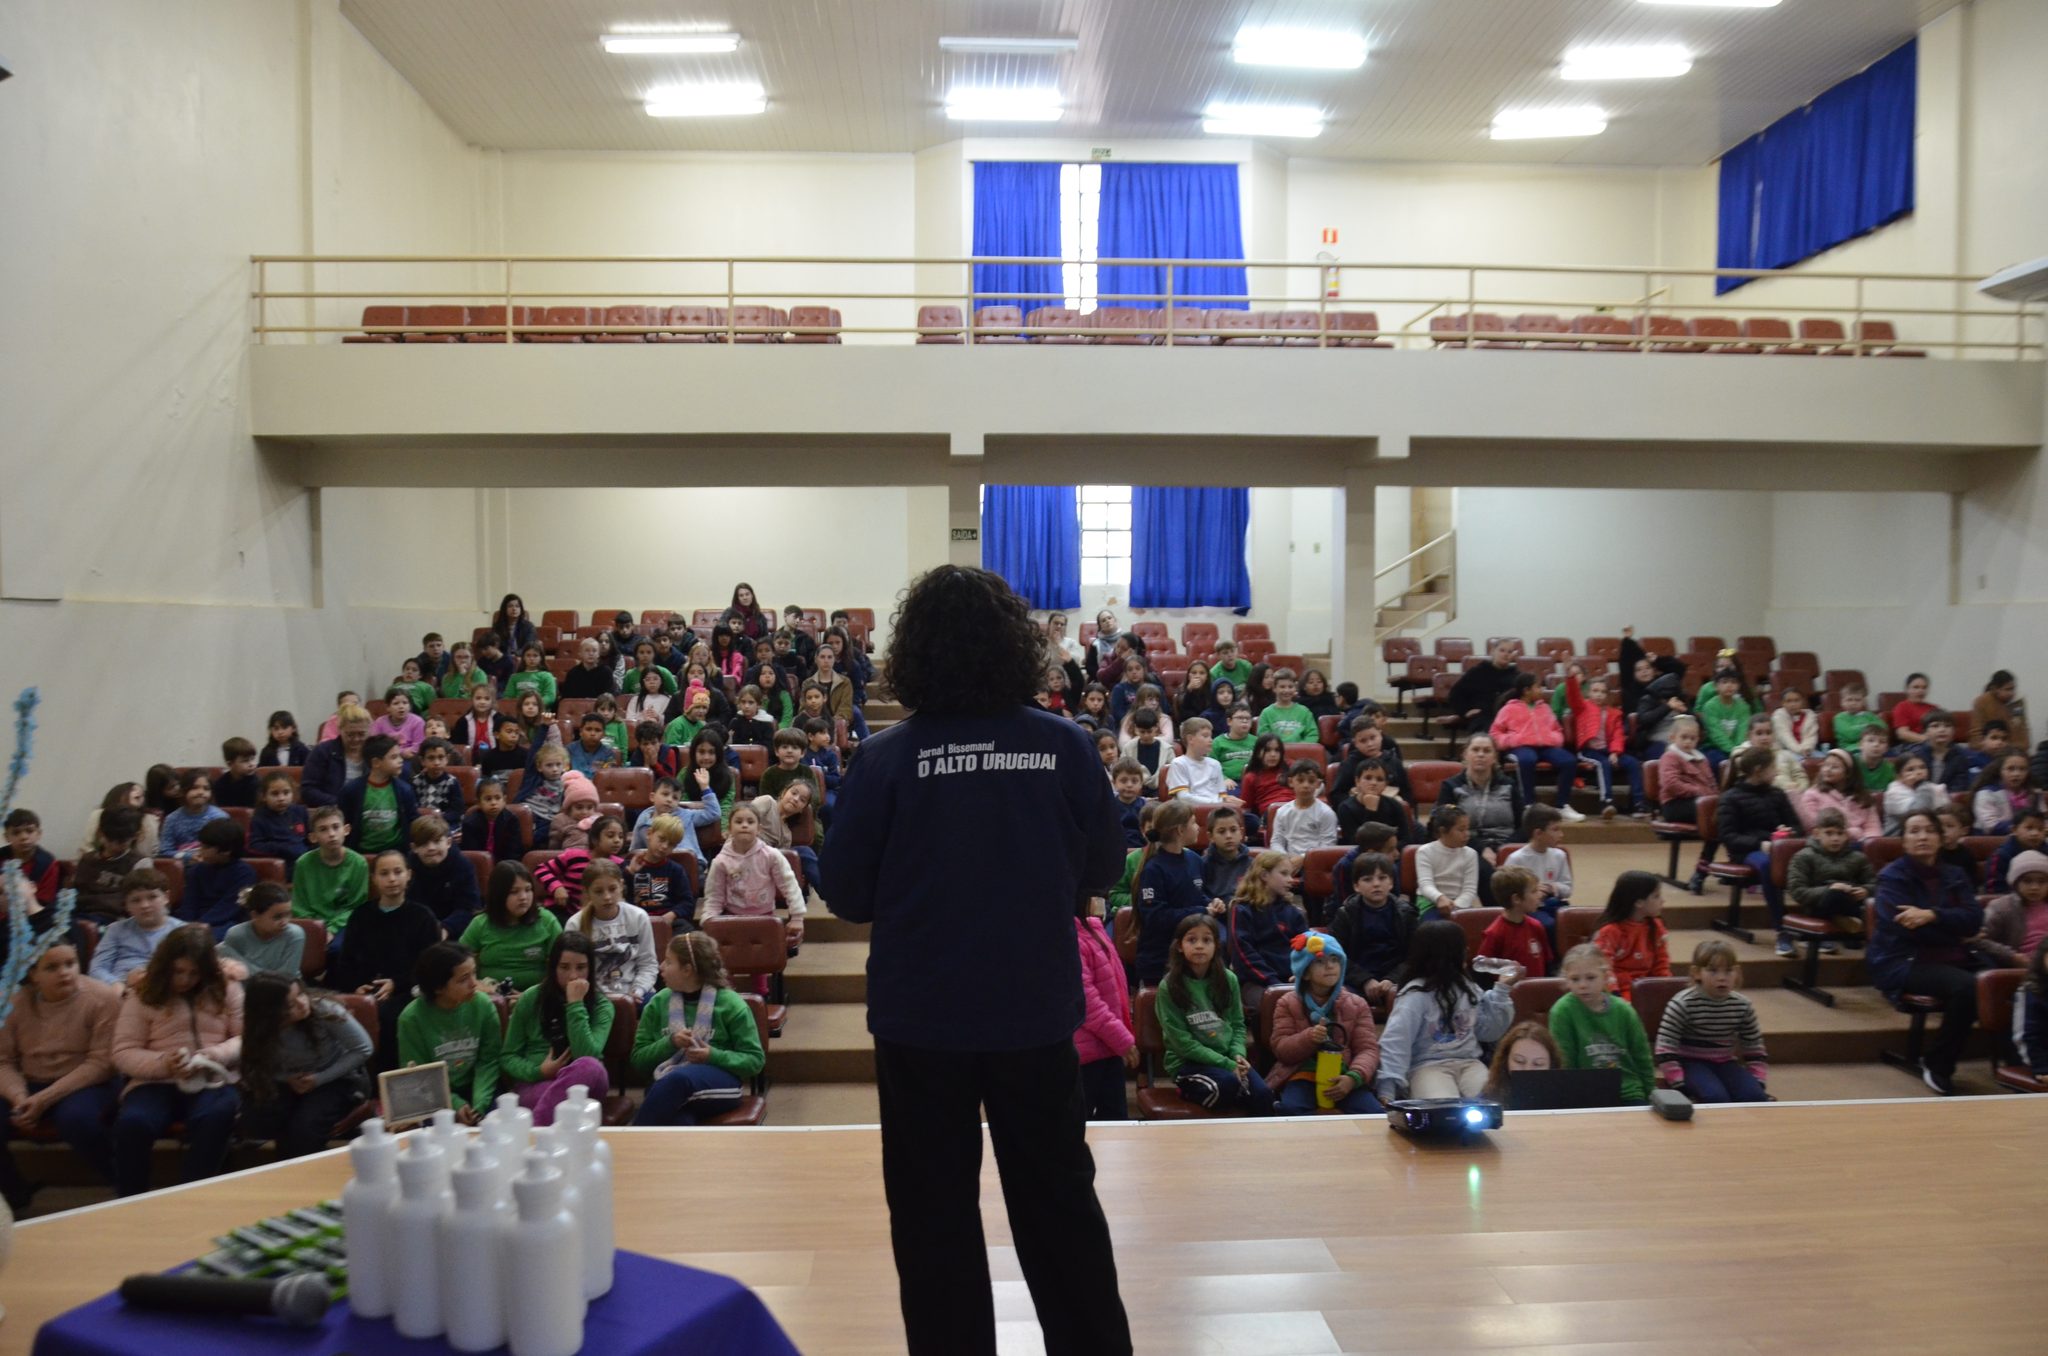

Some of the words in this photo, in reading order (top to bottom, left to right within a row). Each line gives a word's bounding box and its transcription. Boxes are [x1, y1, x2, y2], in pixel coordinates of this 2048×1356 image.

[917, 744, 944, 759] Jornal
[948, 740, 995, 754] Bissemanal
[917, 760, 930, 778] O
[934, 754, 977, 775] ALTO
[982, 753, 1057, 770] URUGUAI
